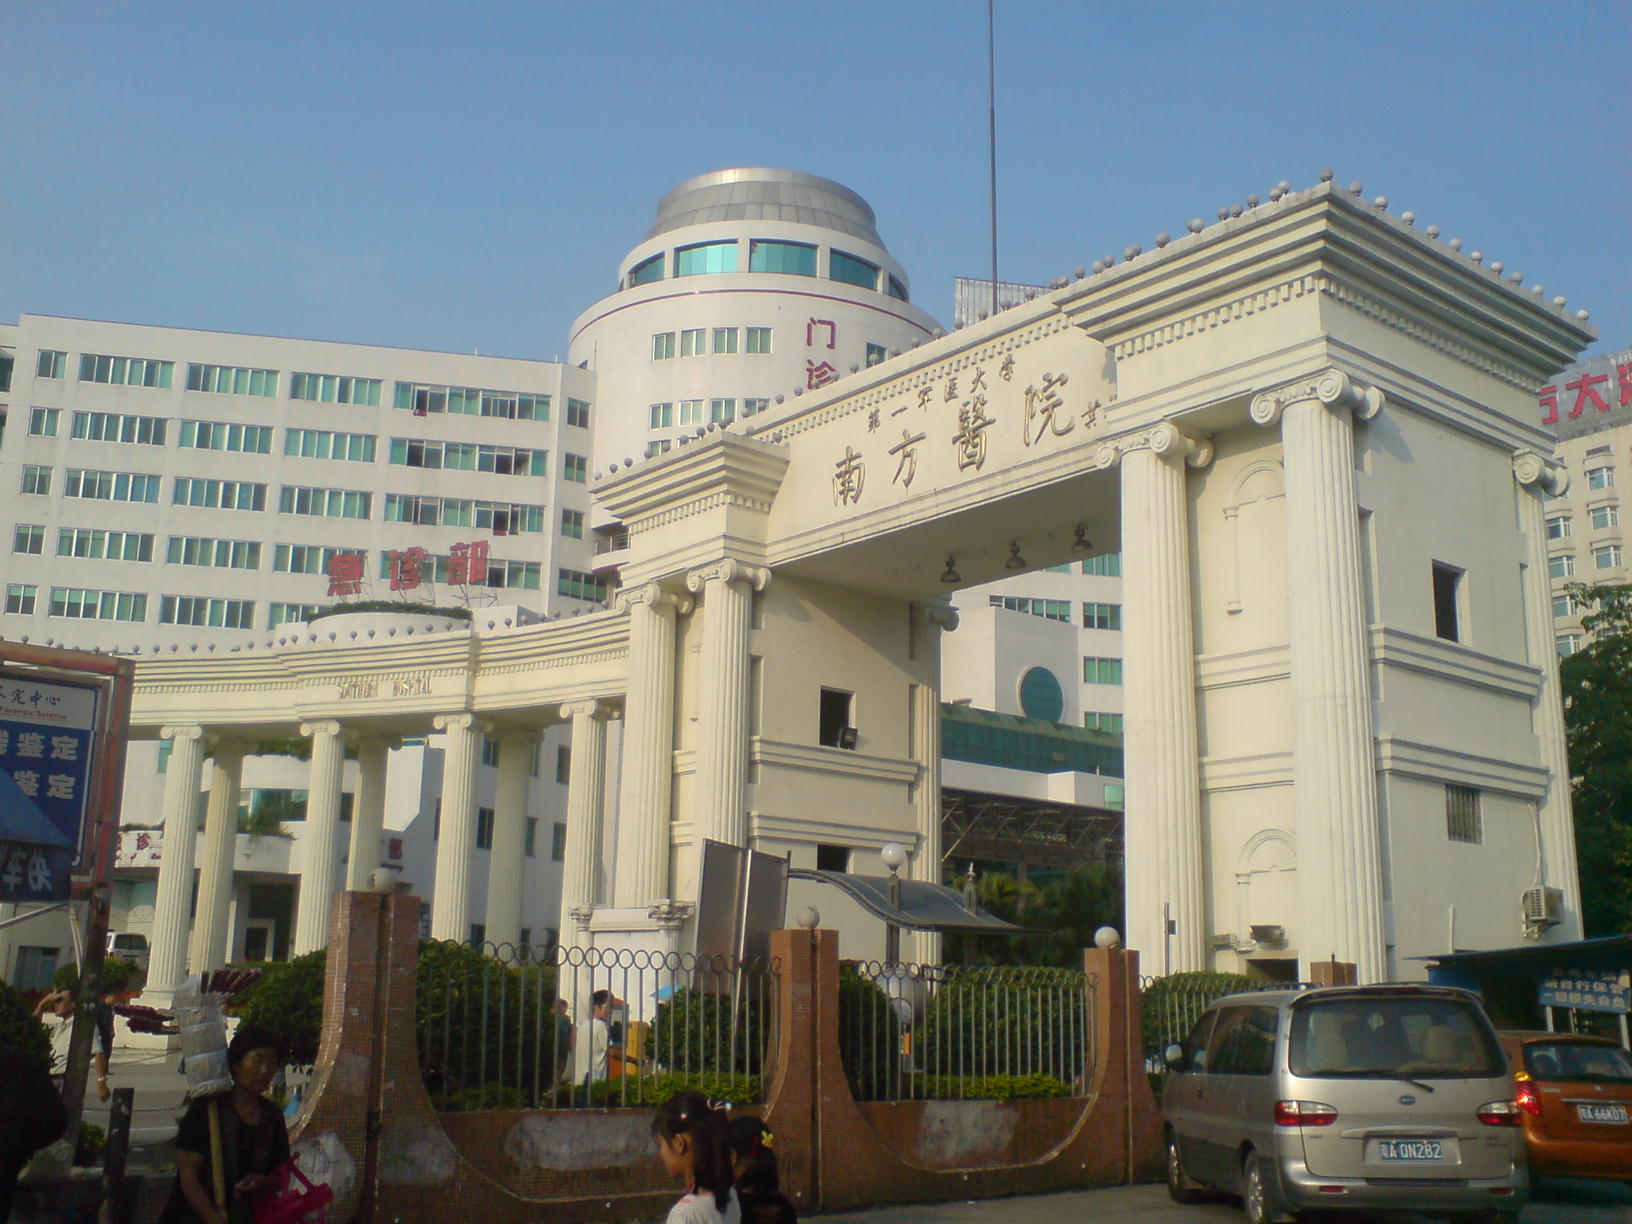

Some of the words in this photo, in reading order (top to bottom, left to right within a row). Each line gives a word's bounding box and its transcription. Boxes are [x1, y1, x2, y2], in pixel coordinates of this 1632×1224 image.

[326, 540, 489, 597] 急诊部
[392, 675, 432, 697] HOSPITAL
[0, 705, 36, 718] Forensic
[37, 710, 68, 721] Science
